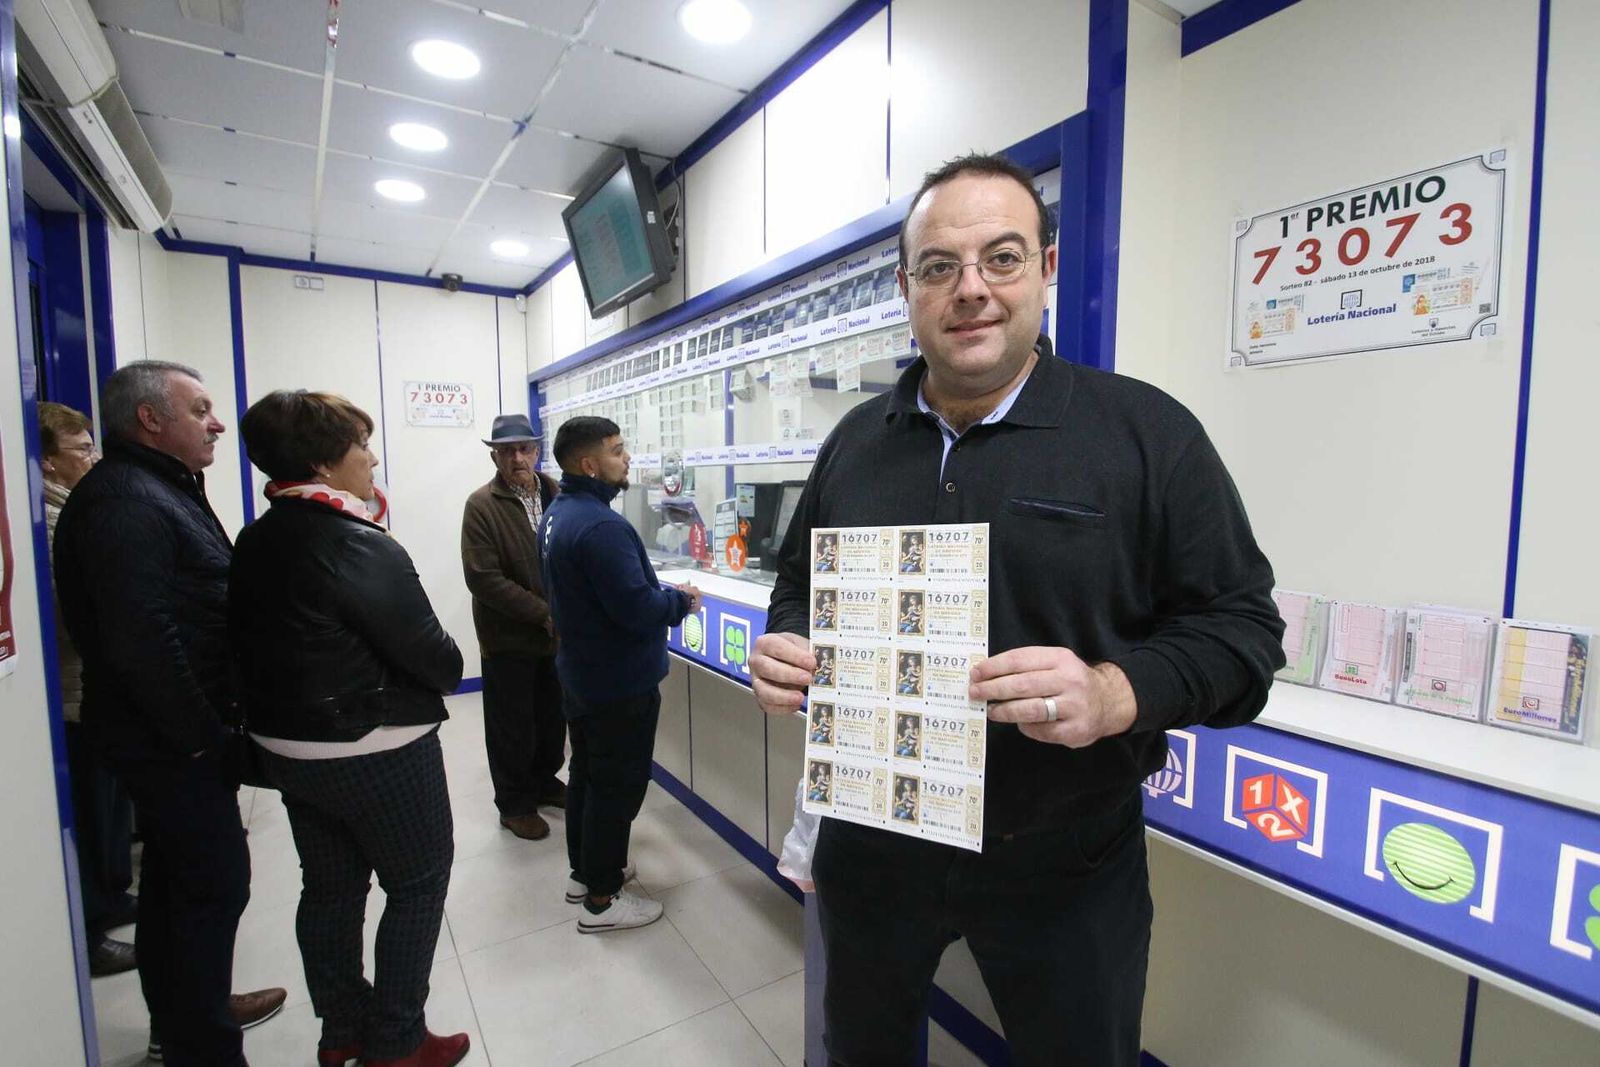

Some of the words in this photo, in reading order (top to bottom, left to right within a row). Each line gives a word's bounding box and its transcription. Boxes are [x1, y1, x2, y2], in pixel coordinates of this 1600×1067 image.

[1306, 175, 1446, 232] PREMIO
[1252, 203, 1473, 286] 73073
[1280, 282, 1303, 291] Sorteo
[1320, 272, 1346, 284] sábado
[1348, 271, 1357, 279] 13
[1358, 268, 1369, 277] de
[1369, 261, 1401, 276] octubre
[1402, 259, 1413, 268] de
[1414, 255, 1436, 266] 2018
[1307, 311, 1346, 326] Lotería
[1347, 303, 1397, 320] Nacional
[425, 383, 461, 392] PREMIO
[410, 392, 468, 405] 73073
[842, 534, 878, 543] 16707
[928, 532, 969, 541] 16707
[840, 591, 876, 601] 16707
[927, 594, 969, 604] 16707
[839, 649, 874, 659] 16707
[926, 655, 967, 667] 16707
[837, 706, 873, 719] 16707
[924, 718, 965, 731] 16707
[835, 765, 871, 779] 16707
[922, 781, 964, 796] 16707
[1248, 781, 1263, 804] 1
[1281, 784, 1302, 825] X
[1257, 812, 1294, 839] 2
